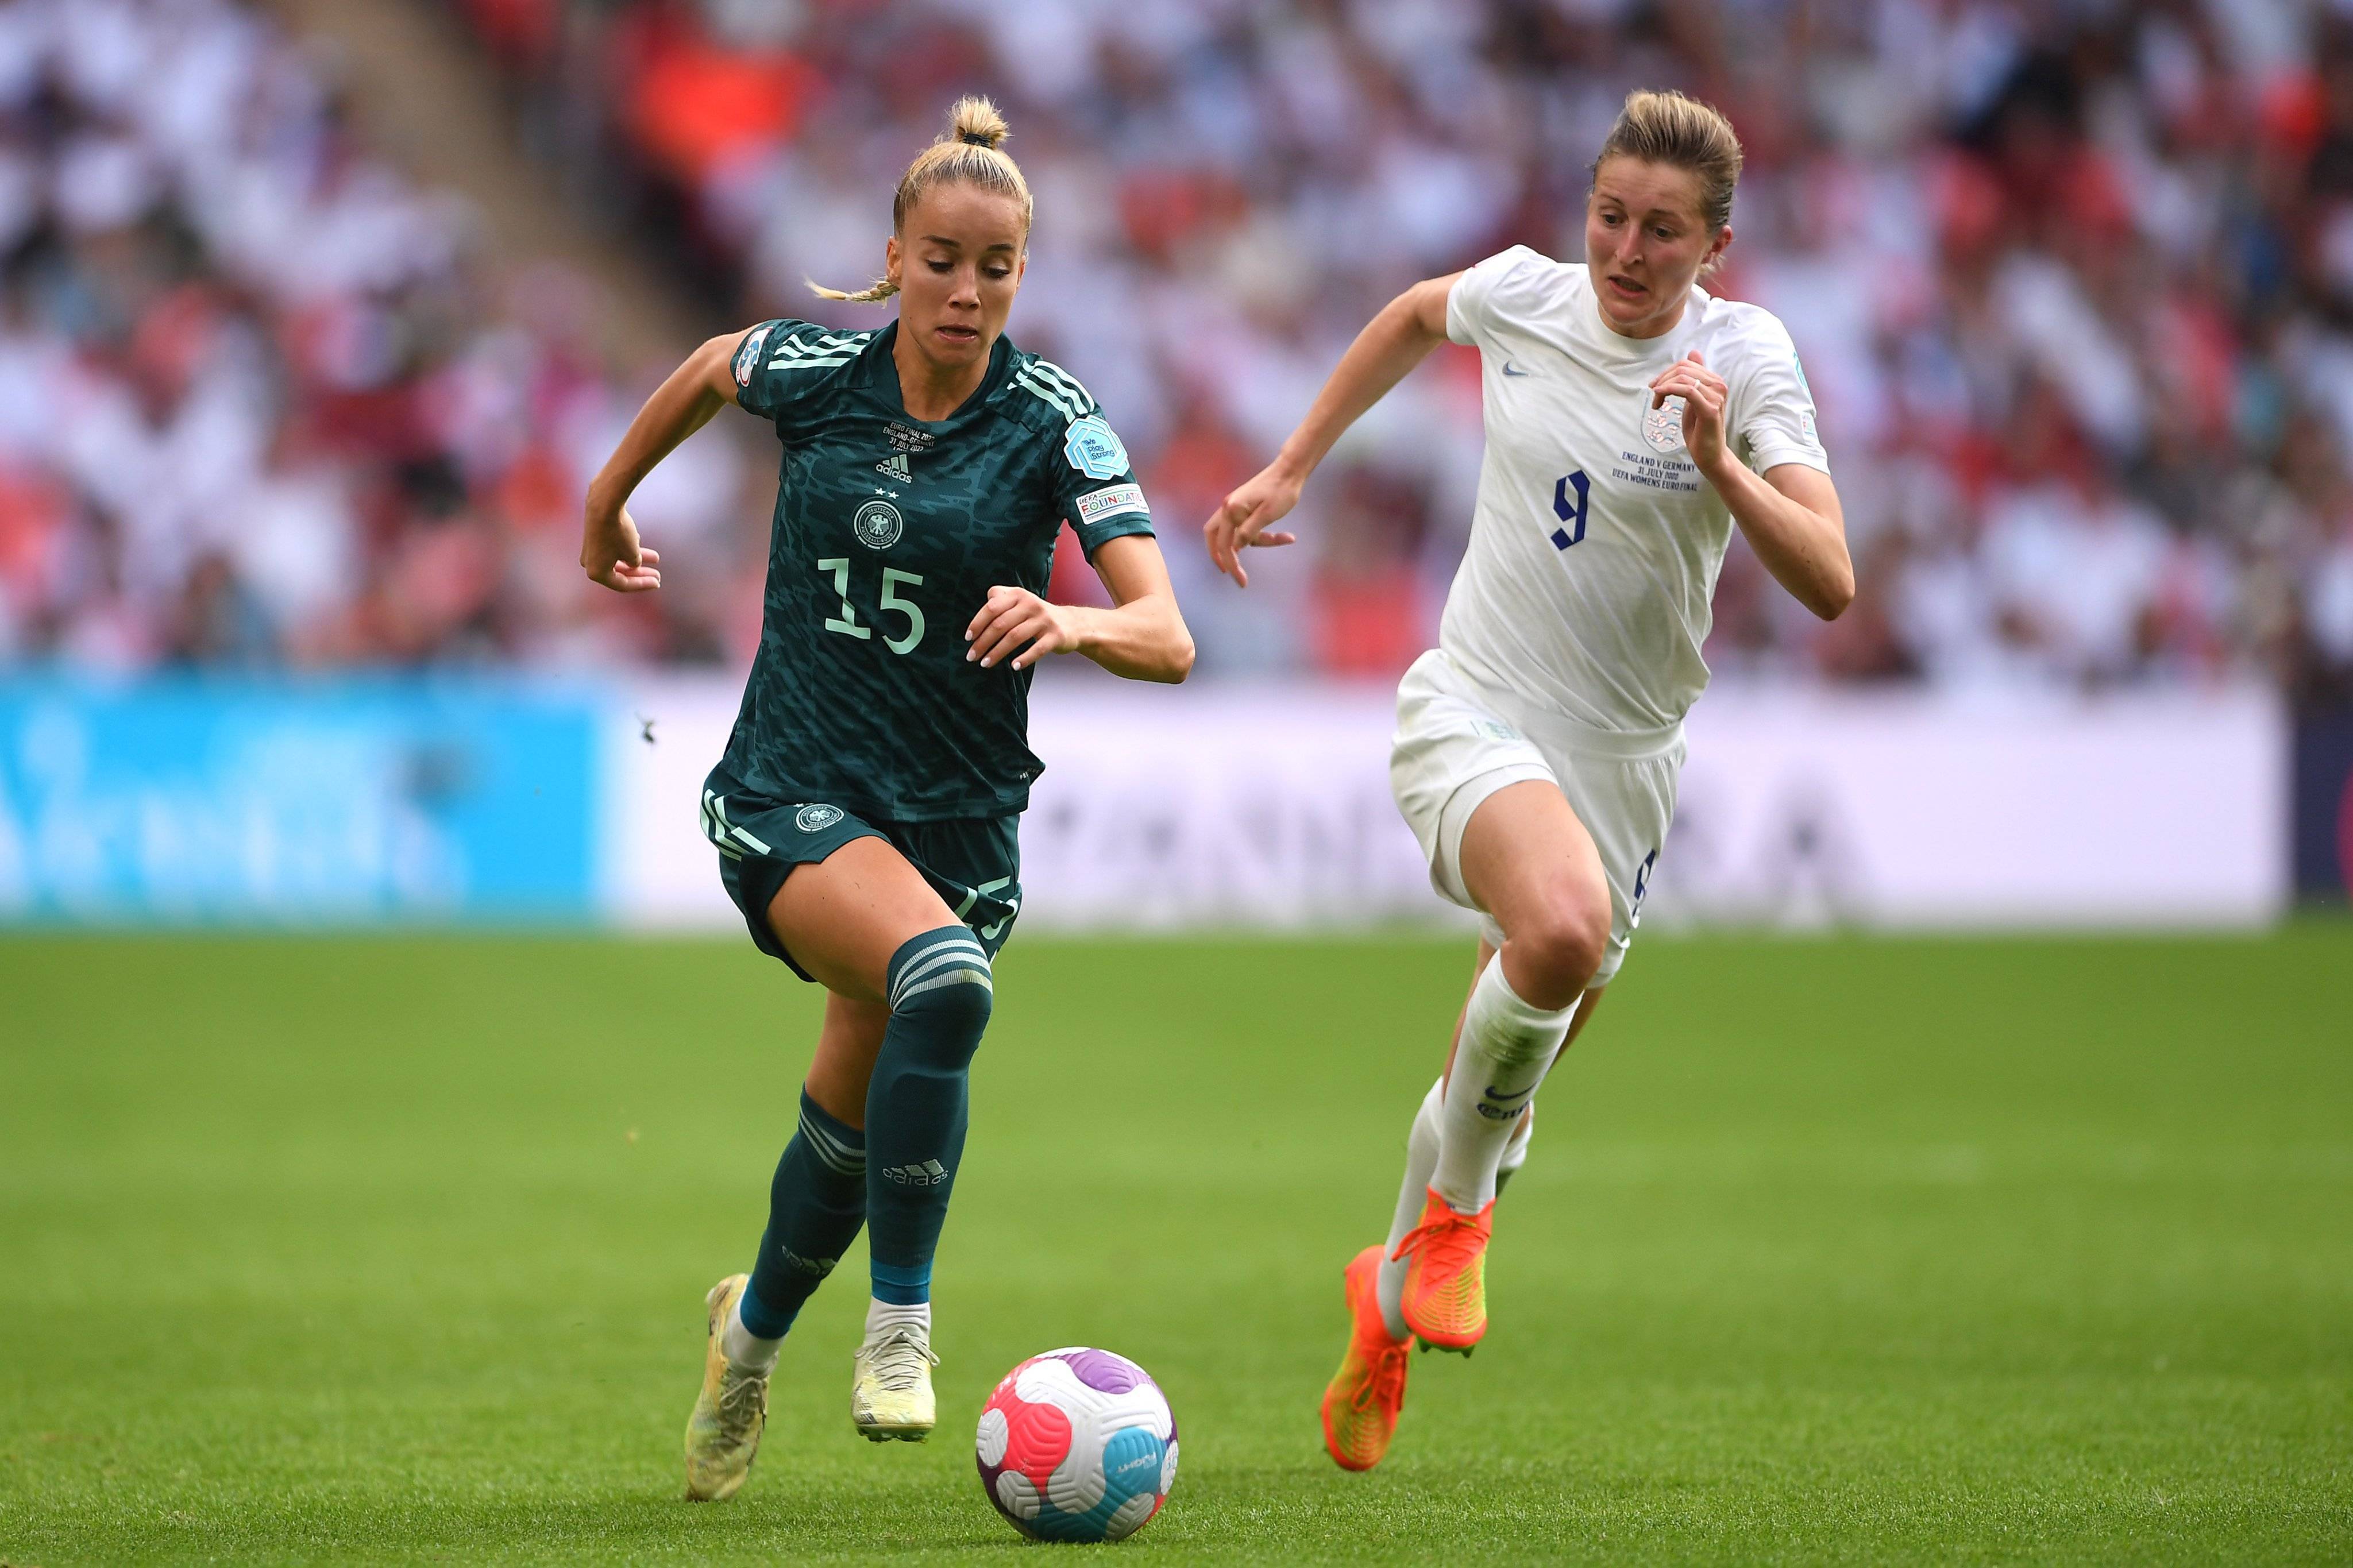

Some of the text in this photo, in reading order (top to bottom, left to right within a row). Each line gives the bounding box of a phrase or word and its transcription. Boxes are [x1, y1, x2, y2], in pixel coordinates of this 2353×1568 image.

[890, 422, 905, 431] EURO
[905, 428, 920, 438] FINAL
[889, 437, 896, 445] 31
[897, 441, 910, 450] JULY
[1091, 450, 1115, 459] Strong
[1622, 451, 1655, 466] ENGLAND
[1662, 461, 1695, 472] GERMANY
[875, 464, 912, 484] adidas
[1612, 468, 1697, 492] UEFA WOMENS EURO FINAL
[1638, 466, 1644, 474] 31
[1645, 468, 1664, 478] JULY
[1079, 494, 1097, 505] UEFA
[867, 507, 894, 519] DEUTSCHER
[1550, 470, 1591, 551] 9
[817, 558, 925, 655] 15
[883, 1168, 948, 1186] adidas
